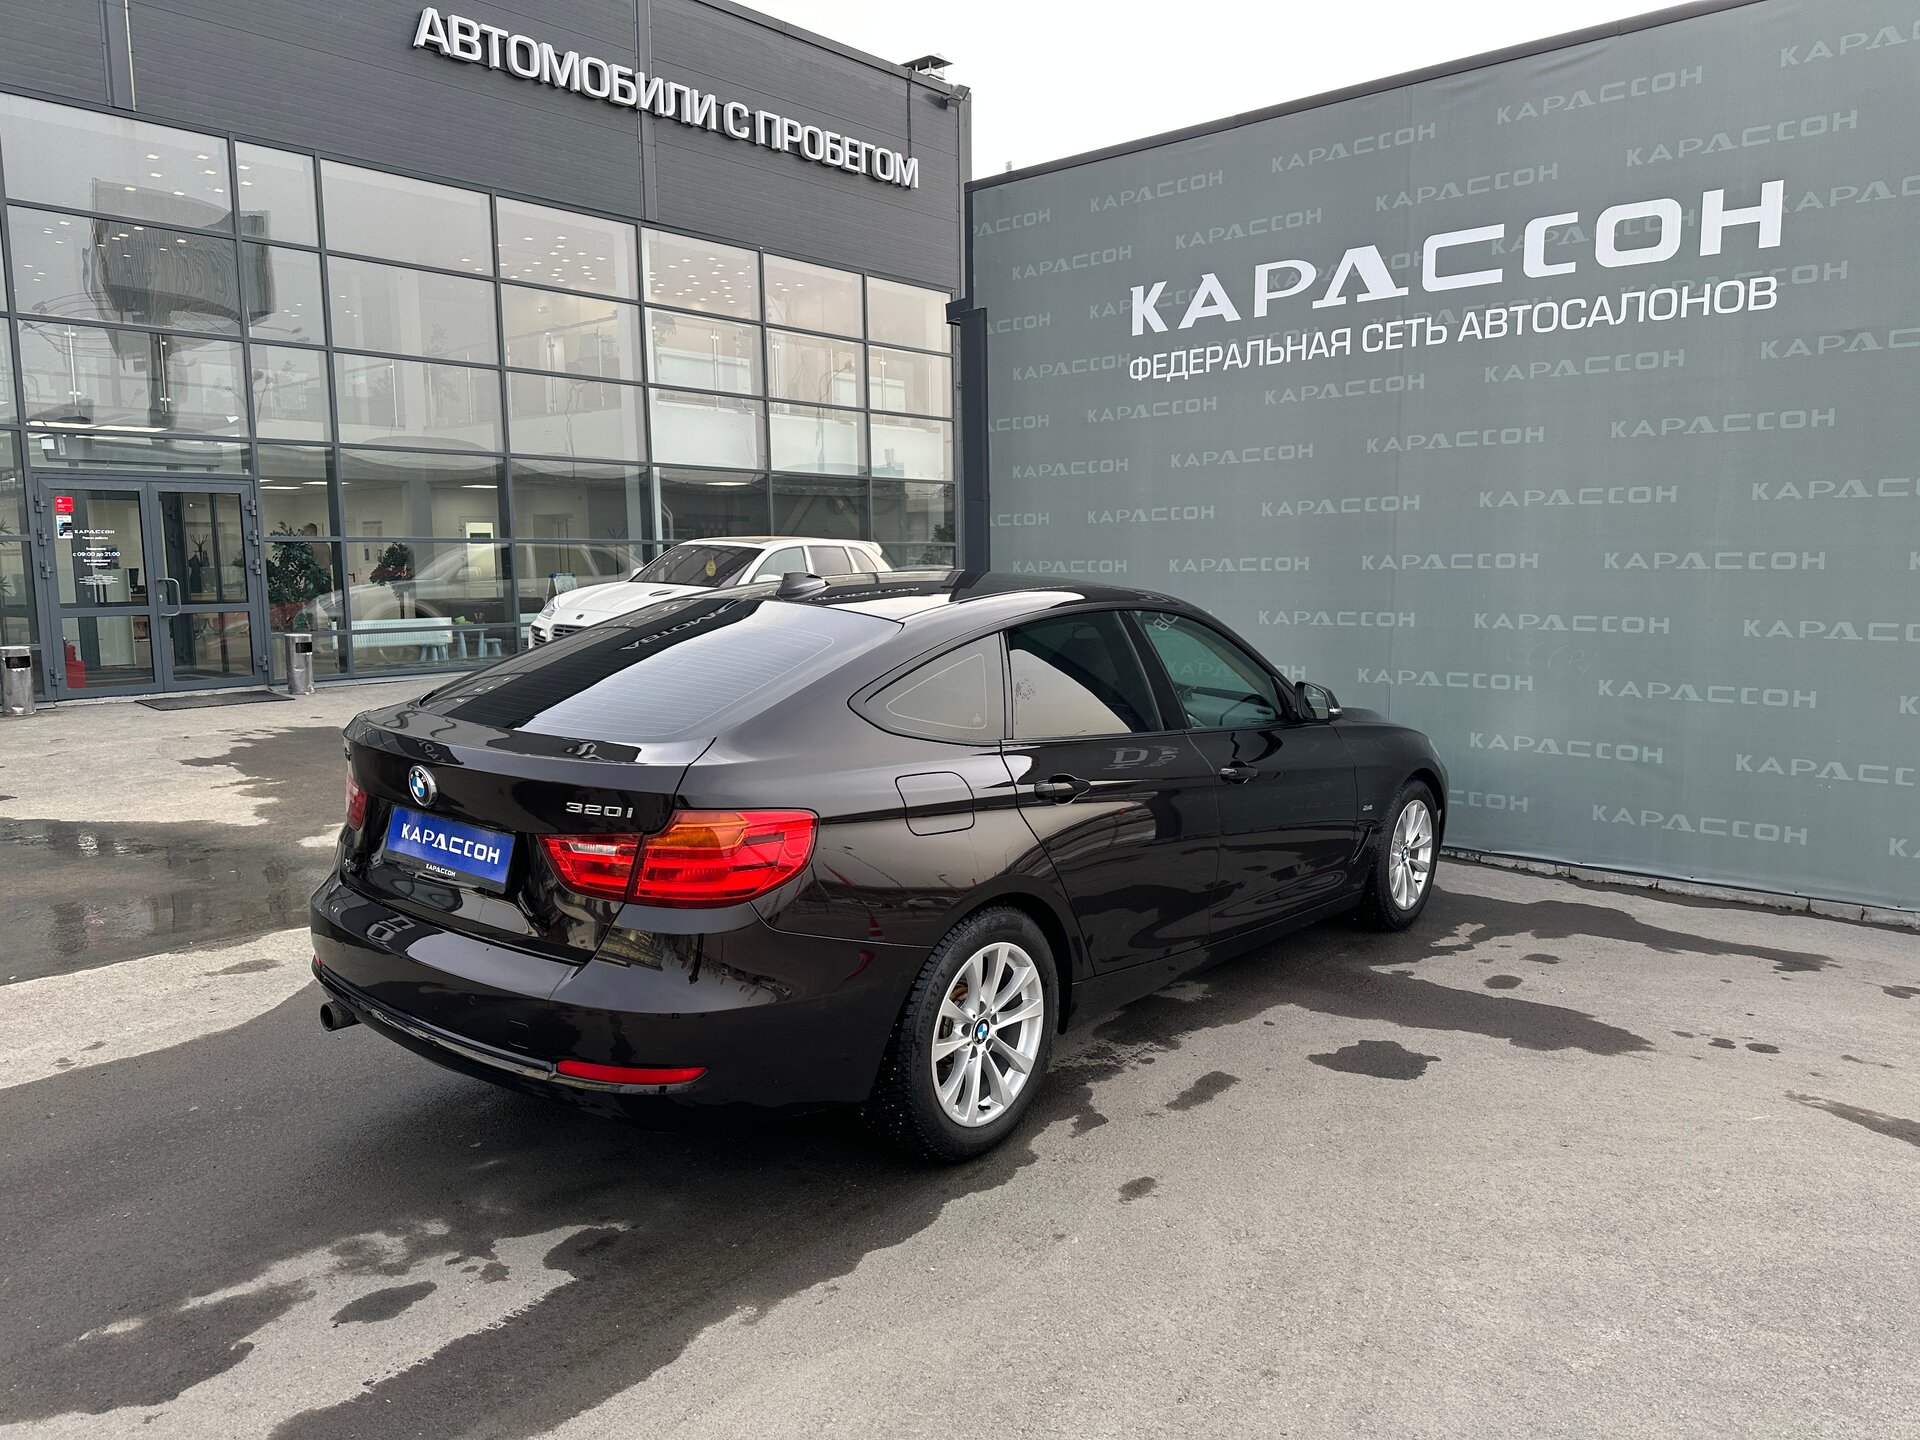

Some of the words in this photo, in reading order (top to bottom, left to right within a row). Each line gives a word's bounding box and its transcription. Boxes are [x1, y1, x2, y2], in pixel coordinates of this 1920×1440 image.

[1779, 20, 1920, 68] КАРА
[415, 7, 718, 132] АВТОМОБИЛИ
[723, 102, 750, 138] С
[755, 110, 919, 189] ПРОБЕГОМ
[1130, 180, 1784, 337] КАРАССОН
[1129, 328, 1351, 382] ФЕДЕРАЛЬНАЯ
[1362, 316, 1448, 353] СЕТЬ
[1458, 276, 1778, 342] АВТОСАЛОНОВ
[1751, 477, 1920, 502] КАРАС
[400, 822, 500, 865] КАРАССОН
